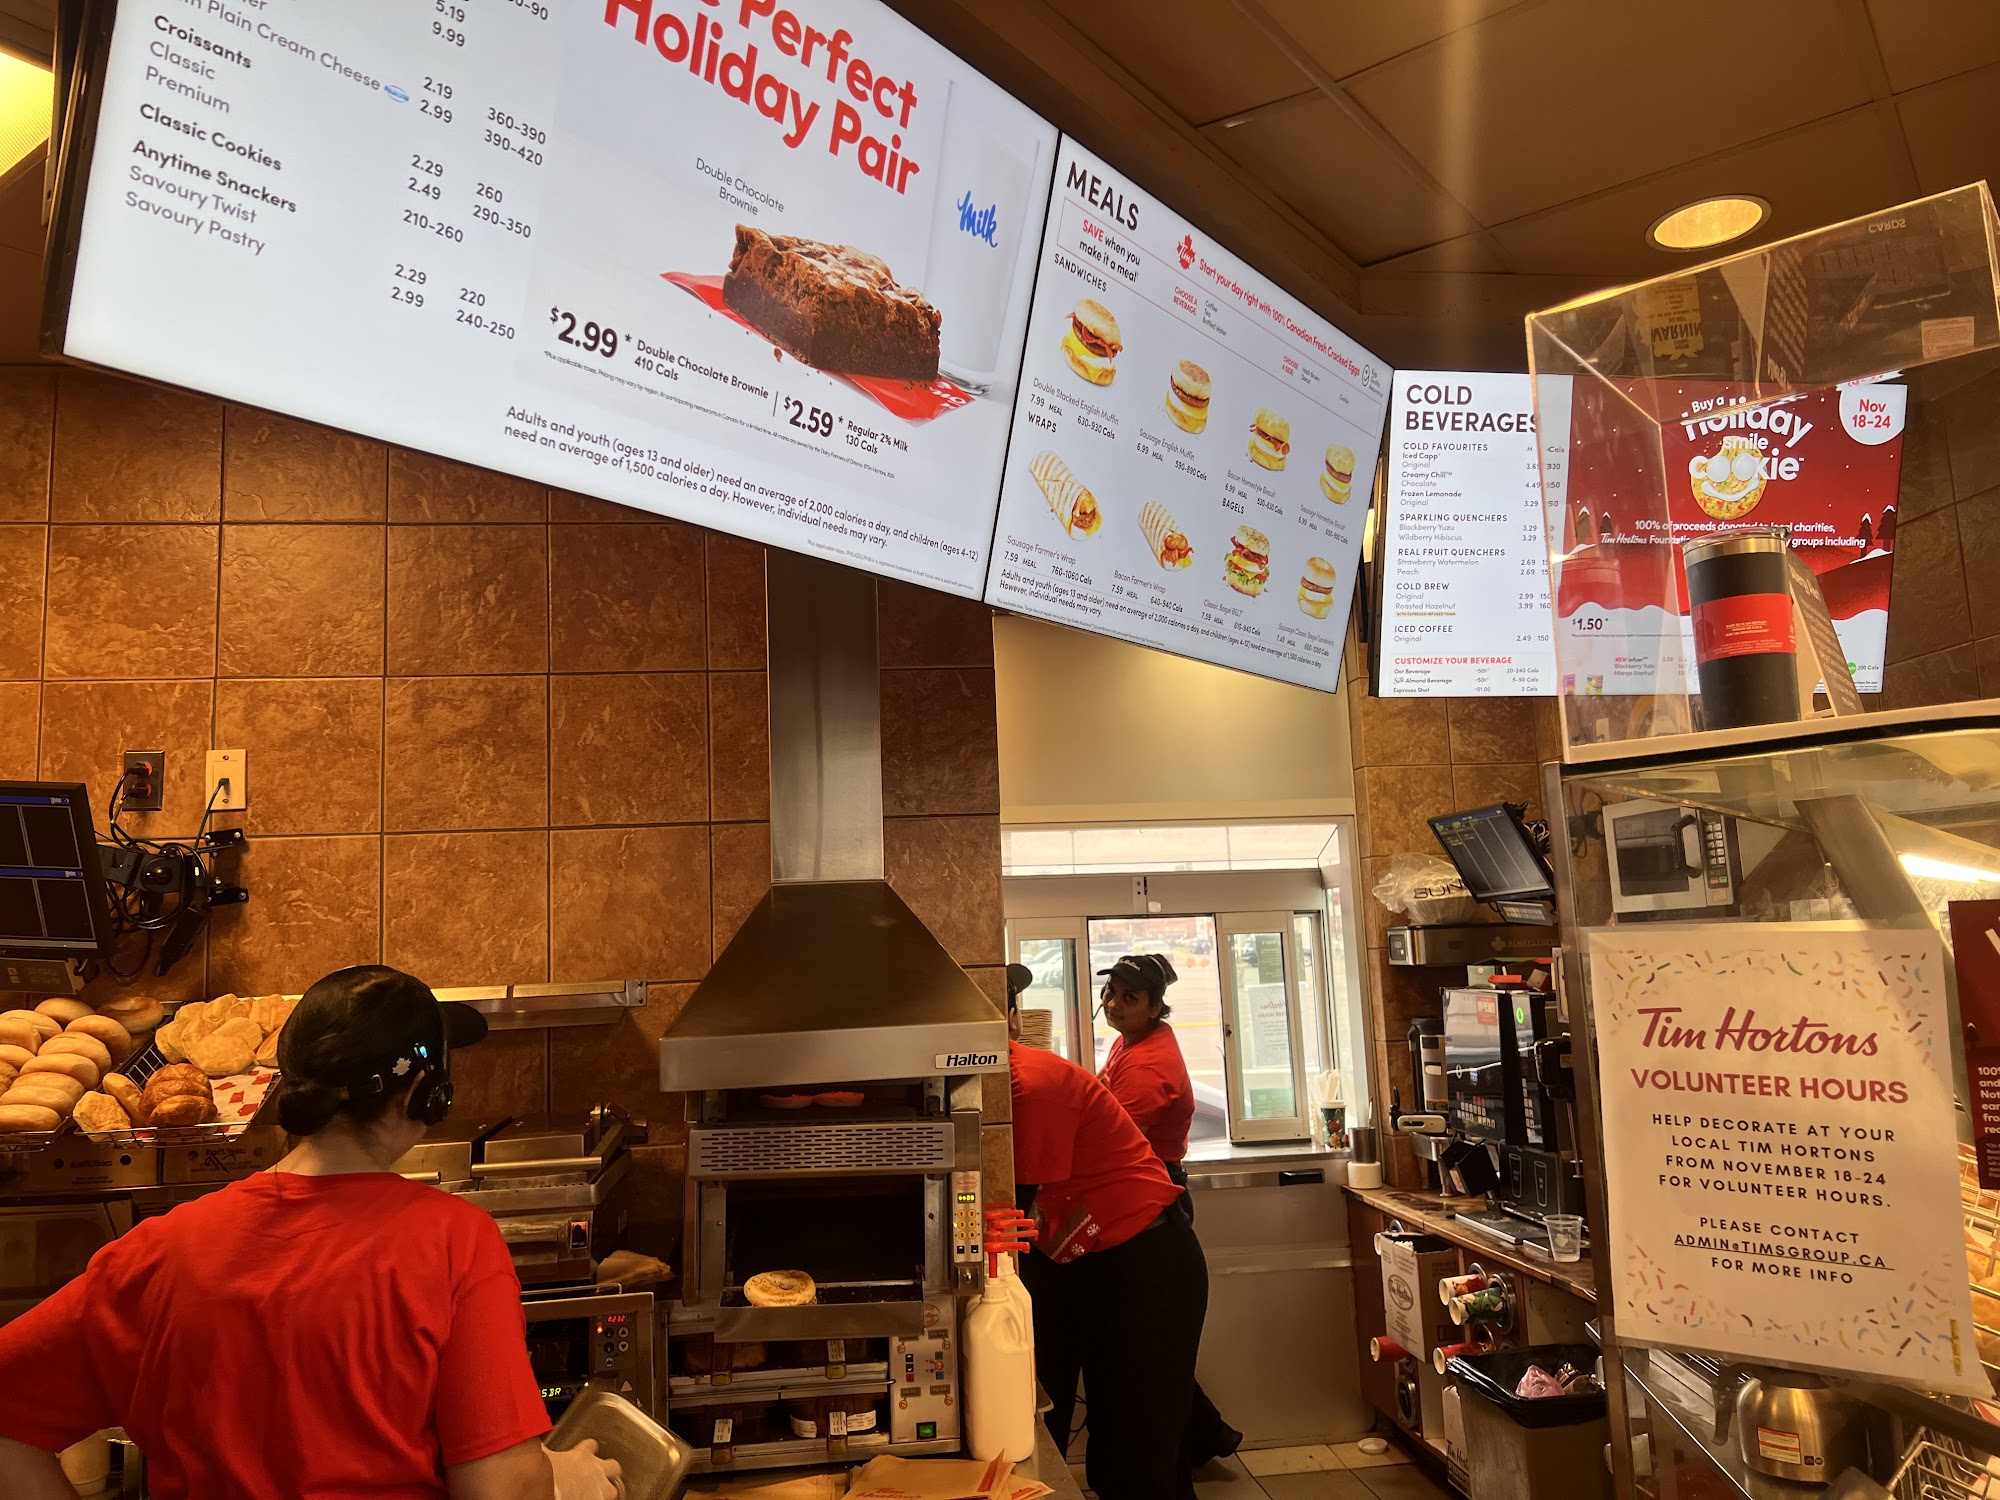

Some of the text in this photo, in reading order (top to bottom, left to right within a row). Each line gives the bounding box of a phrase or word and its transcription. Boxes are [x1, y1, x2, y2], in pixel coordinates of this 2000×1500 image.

[154, 15, 250, 68] Croissants
[207, 0, 380, 90] Plain Cream Cheese
[432, 20, 464, 46] 9.99
[149, 40, 215, 79] Classic
[737, 0, 918, 129] Perfect
[145, 65, 229, 113] Premium
[603, 0, 920, 195] Holiday Pair
[140, 103, 280, 170] Classic Cookies
[487, 106, 545, 144] 360-390
[484, 128, 542, 165] 390-420
[132, 139, 296, 212] Anytime Snackers
[695, 157, 784, 212] Double Chocolate
[129, 164, 256, 223] Savoury Twist
[476, 182, 502, 203] 260
[719, 186, 758, 215] Brownie
[1068, 164, 1138, 230] MEALS
[125, 190, 265, 255] Savoury Pastry
[402, 208, 463, 242] 210-260
[472, 204, 530, 238] 290-350
[957, 190, 999, 248] Milk
[1082, 219, 1140, 265] SAVE when you
[1054, 253, 1106, 291] SANDWICHES
[1079, 240, 1136, 282] make it a meal
[459, 287, 485, 306] 220
[455, 309, 514, 339] 240-250
[1199, 258, 1359, 376] Start your day right with 100% Canadian Fresh Cracked Eggs
[549, 305, 618, 360] $2.99
[634, 355, 653, 371] 410
[655, 363, 678, 380] Cals
[637, 338, 768, 398] Double Chocolate Brownie
[1033, 377, 1118, 425] Double Stacked English Muffin
[1406, 384, 1472, 405] COLD
[1691, 396, 1724, 413] Buy a
[1859, 399, 1886, 413] Nov
[783, 395, 834, 438] $2.59
[1028, 411, 1056, 432] WRAPS
[1405, 411, 1538, 433] BEVERAGES
[1852, 415, 1891, 428] 18-24
[845, 433, 877, 454] 130 Cals
[847, 420, 908, 451] Regular 2% Milk
[1402, 442, 1487, 451] COLD FAVOURITES
[1724, 433, 1769, 450] smile
[506, 405, 978, 562] Adults and youth (ages 13 and older) need an average of 2,000 calories a day, and children (ages 4-12)
[1401, 470, 1429, 479] Creamy
[1222, 497, 1244, 514] BAGELS
[1399, 513, 1507, 521] SPARKLING QUENCHERS
[1601, 532, 1648, 544] Tim Hortons
[1635, 520, 1836, 533] 100% proceeds charities,
[1450, 548, 1505, 556] QUENCHERS
[1792, 536, 1866, 548] groups including
[1396, 582, 1449, 590] COLD BREW
[1572, 618, 1603, 631] $1.50
[1470, 656, 1511, 664] BEVERAGE
[1637, 1006, 1880, 1057] Tim Hortons
[945, 1052, 998, 1067] Halton
[1630, 1068, 1909, 1104] VOLUNTEER HOURS
[1652, 1113, 1894, 1141] HELP DECORATE AT YOUR
[1671, 1135, 1874, 1162] LOCAL TIM HORTONS
[1666, 1154, 1885, 1184] FROM NOVEMBER 18-24
[1659, 1174, 1890, 1207] FOR VOLUNTEER HOURS.
[1700, 1216, 1858, 1243] PLEASE CONTACT
[1674, 1233, 1887, 1268] ADMIN@TIMSGROUP.CA
[1711, 1256, 1852, 1283] FOR MORE INFO
